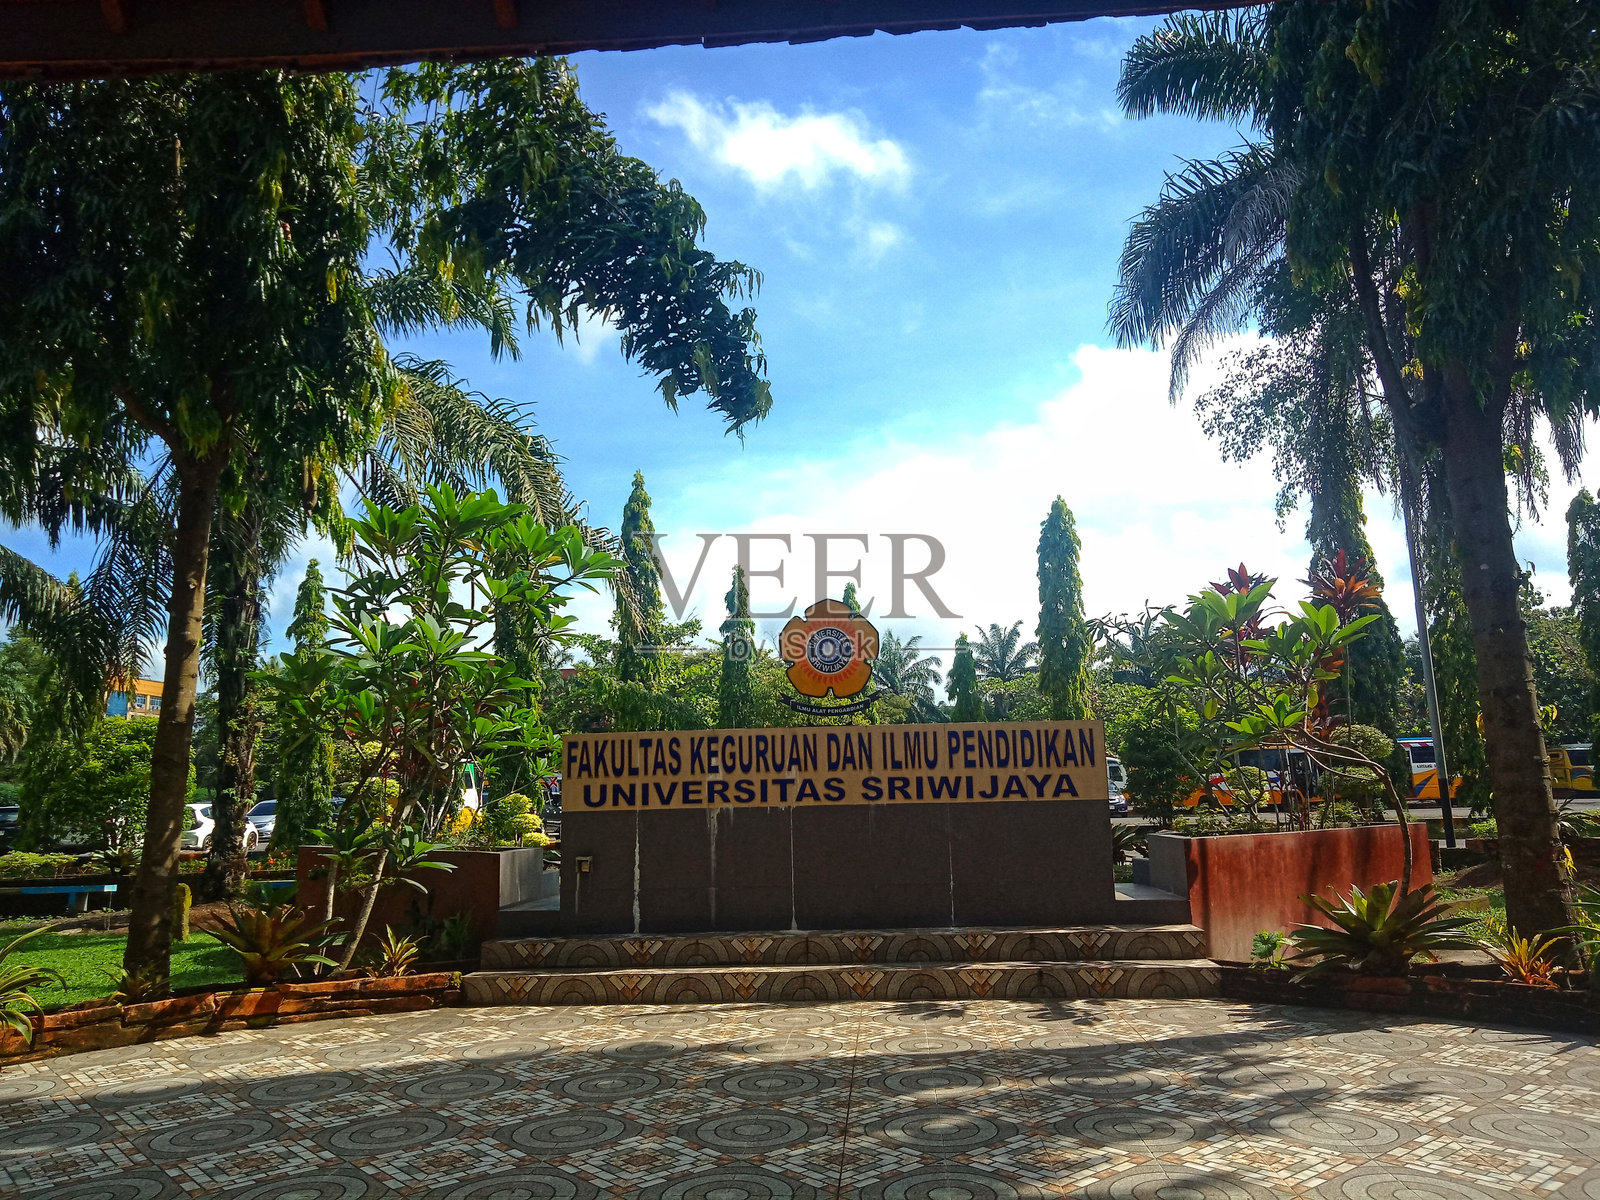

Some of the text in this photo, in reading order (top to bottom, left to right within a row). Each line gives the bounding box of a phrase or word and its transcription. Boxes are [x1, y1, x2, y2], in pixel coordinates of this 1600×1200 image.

[809, 629, 850, 650] UNIVERSITAS
[810, 655, 851, 674] SRIWIJAYA
[796, 705, 811, 713] ILMU
[827, 704, 864, 714] PENGABDIAN
[566, 728, 1096, 779] FAKULTAS KEGURUAN DAN ILMU PENDIDIKAN
[583, 774, 1079, 808] UNIVERSITAS SRIWIJAYA
